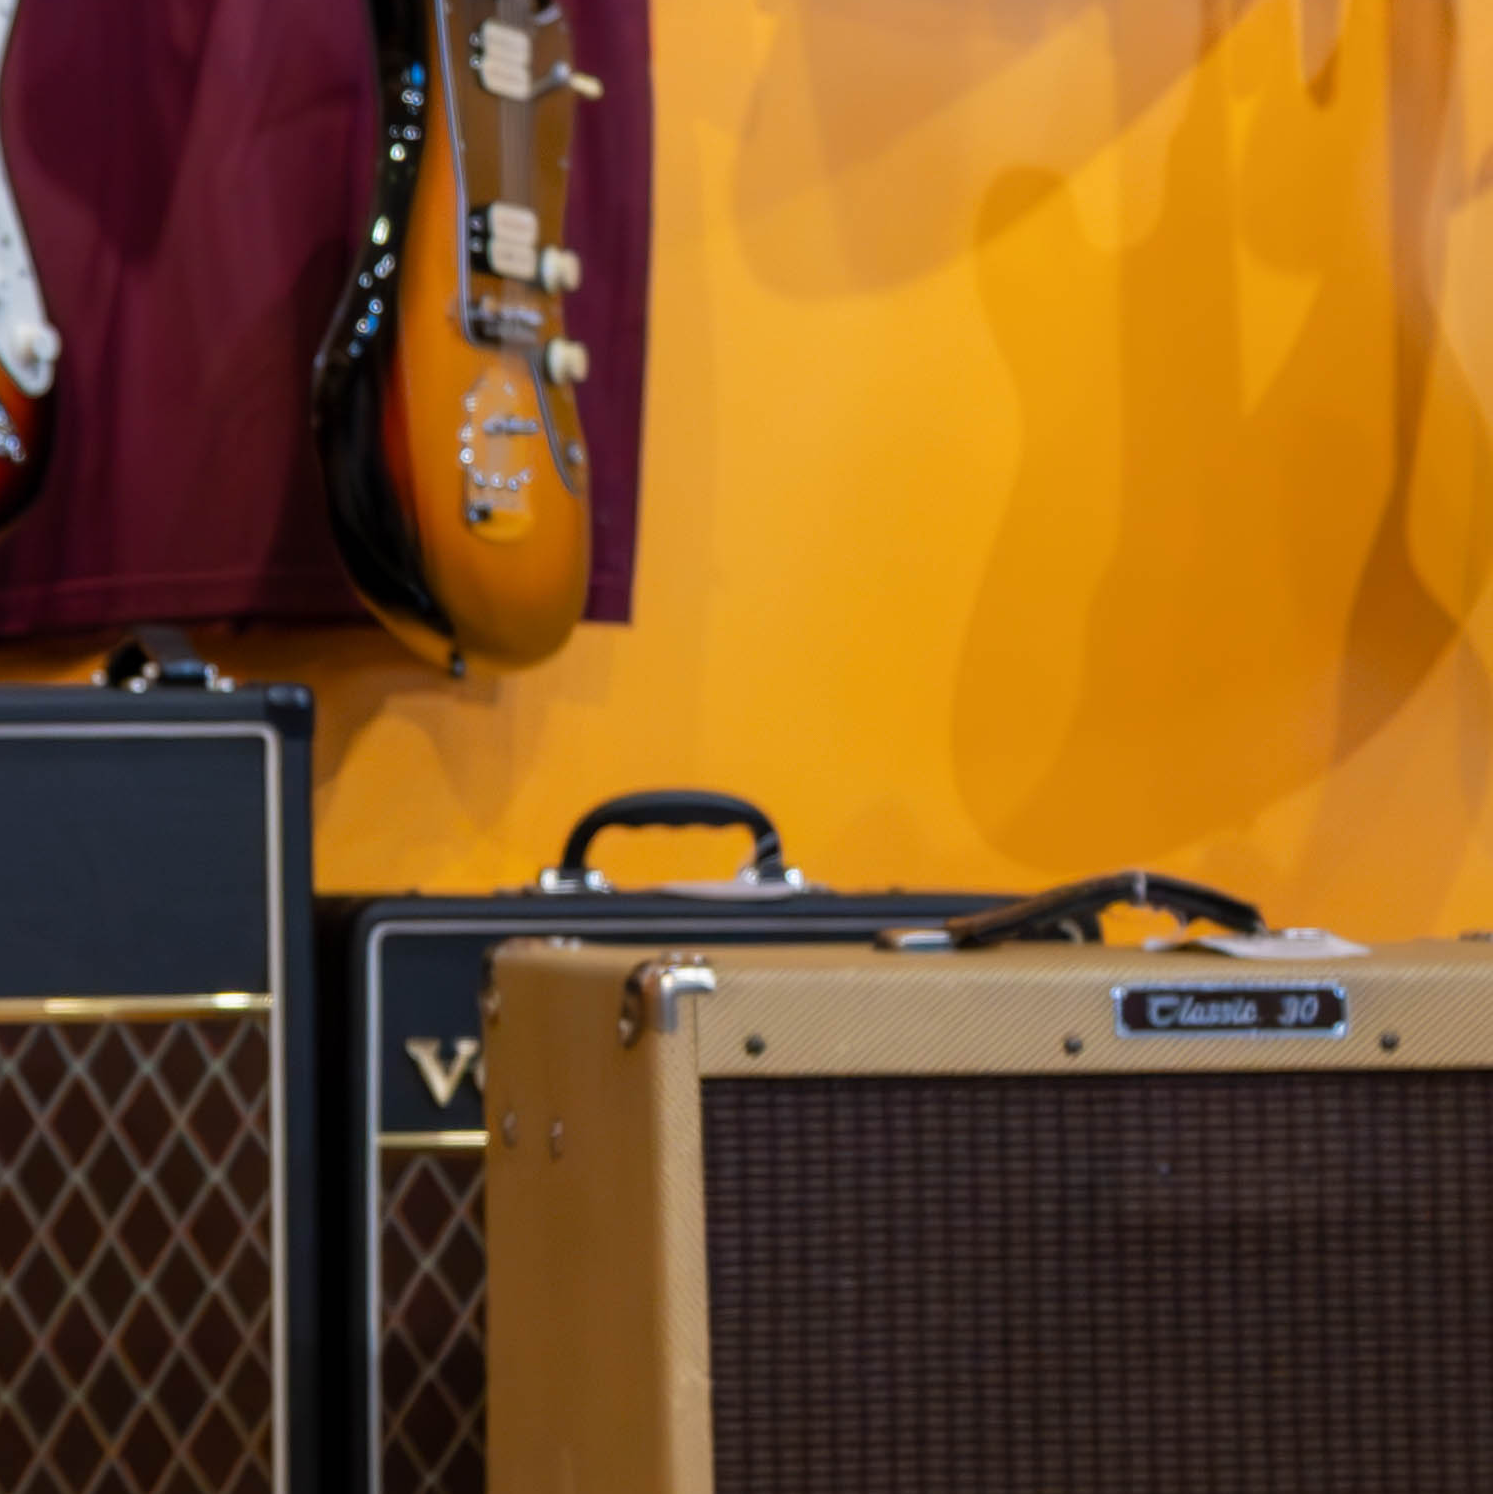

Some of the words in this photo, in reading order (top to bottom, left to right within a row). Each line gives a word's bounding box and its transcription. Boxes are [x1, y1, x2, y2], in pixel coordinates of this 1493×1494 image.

[1145, 994, 1259, 1027] Classic
[1277, 994, 1321, 1027] 30
[404, 1037, 486, 1108] V
